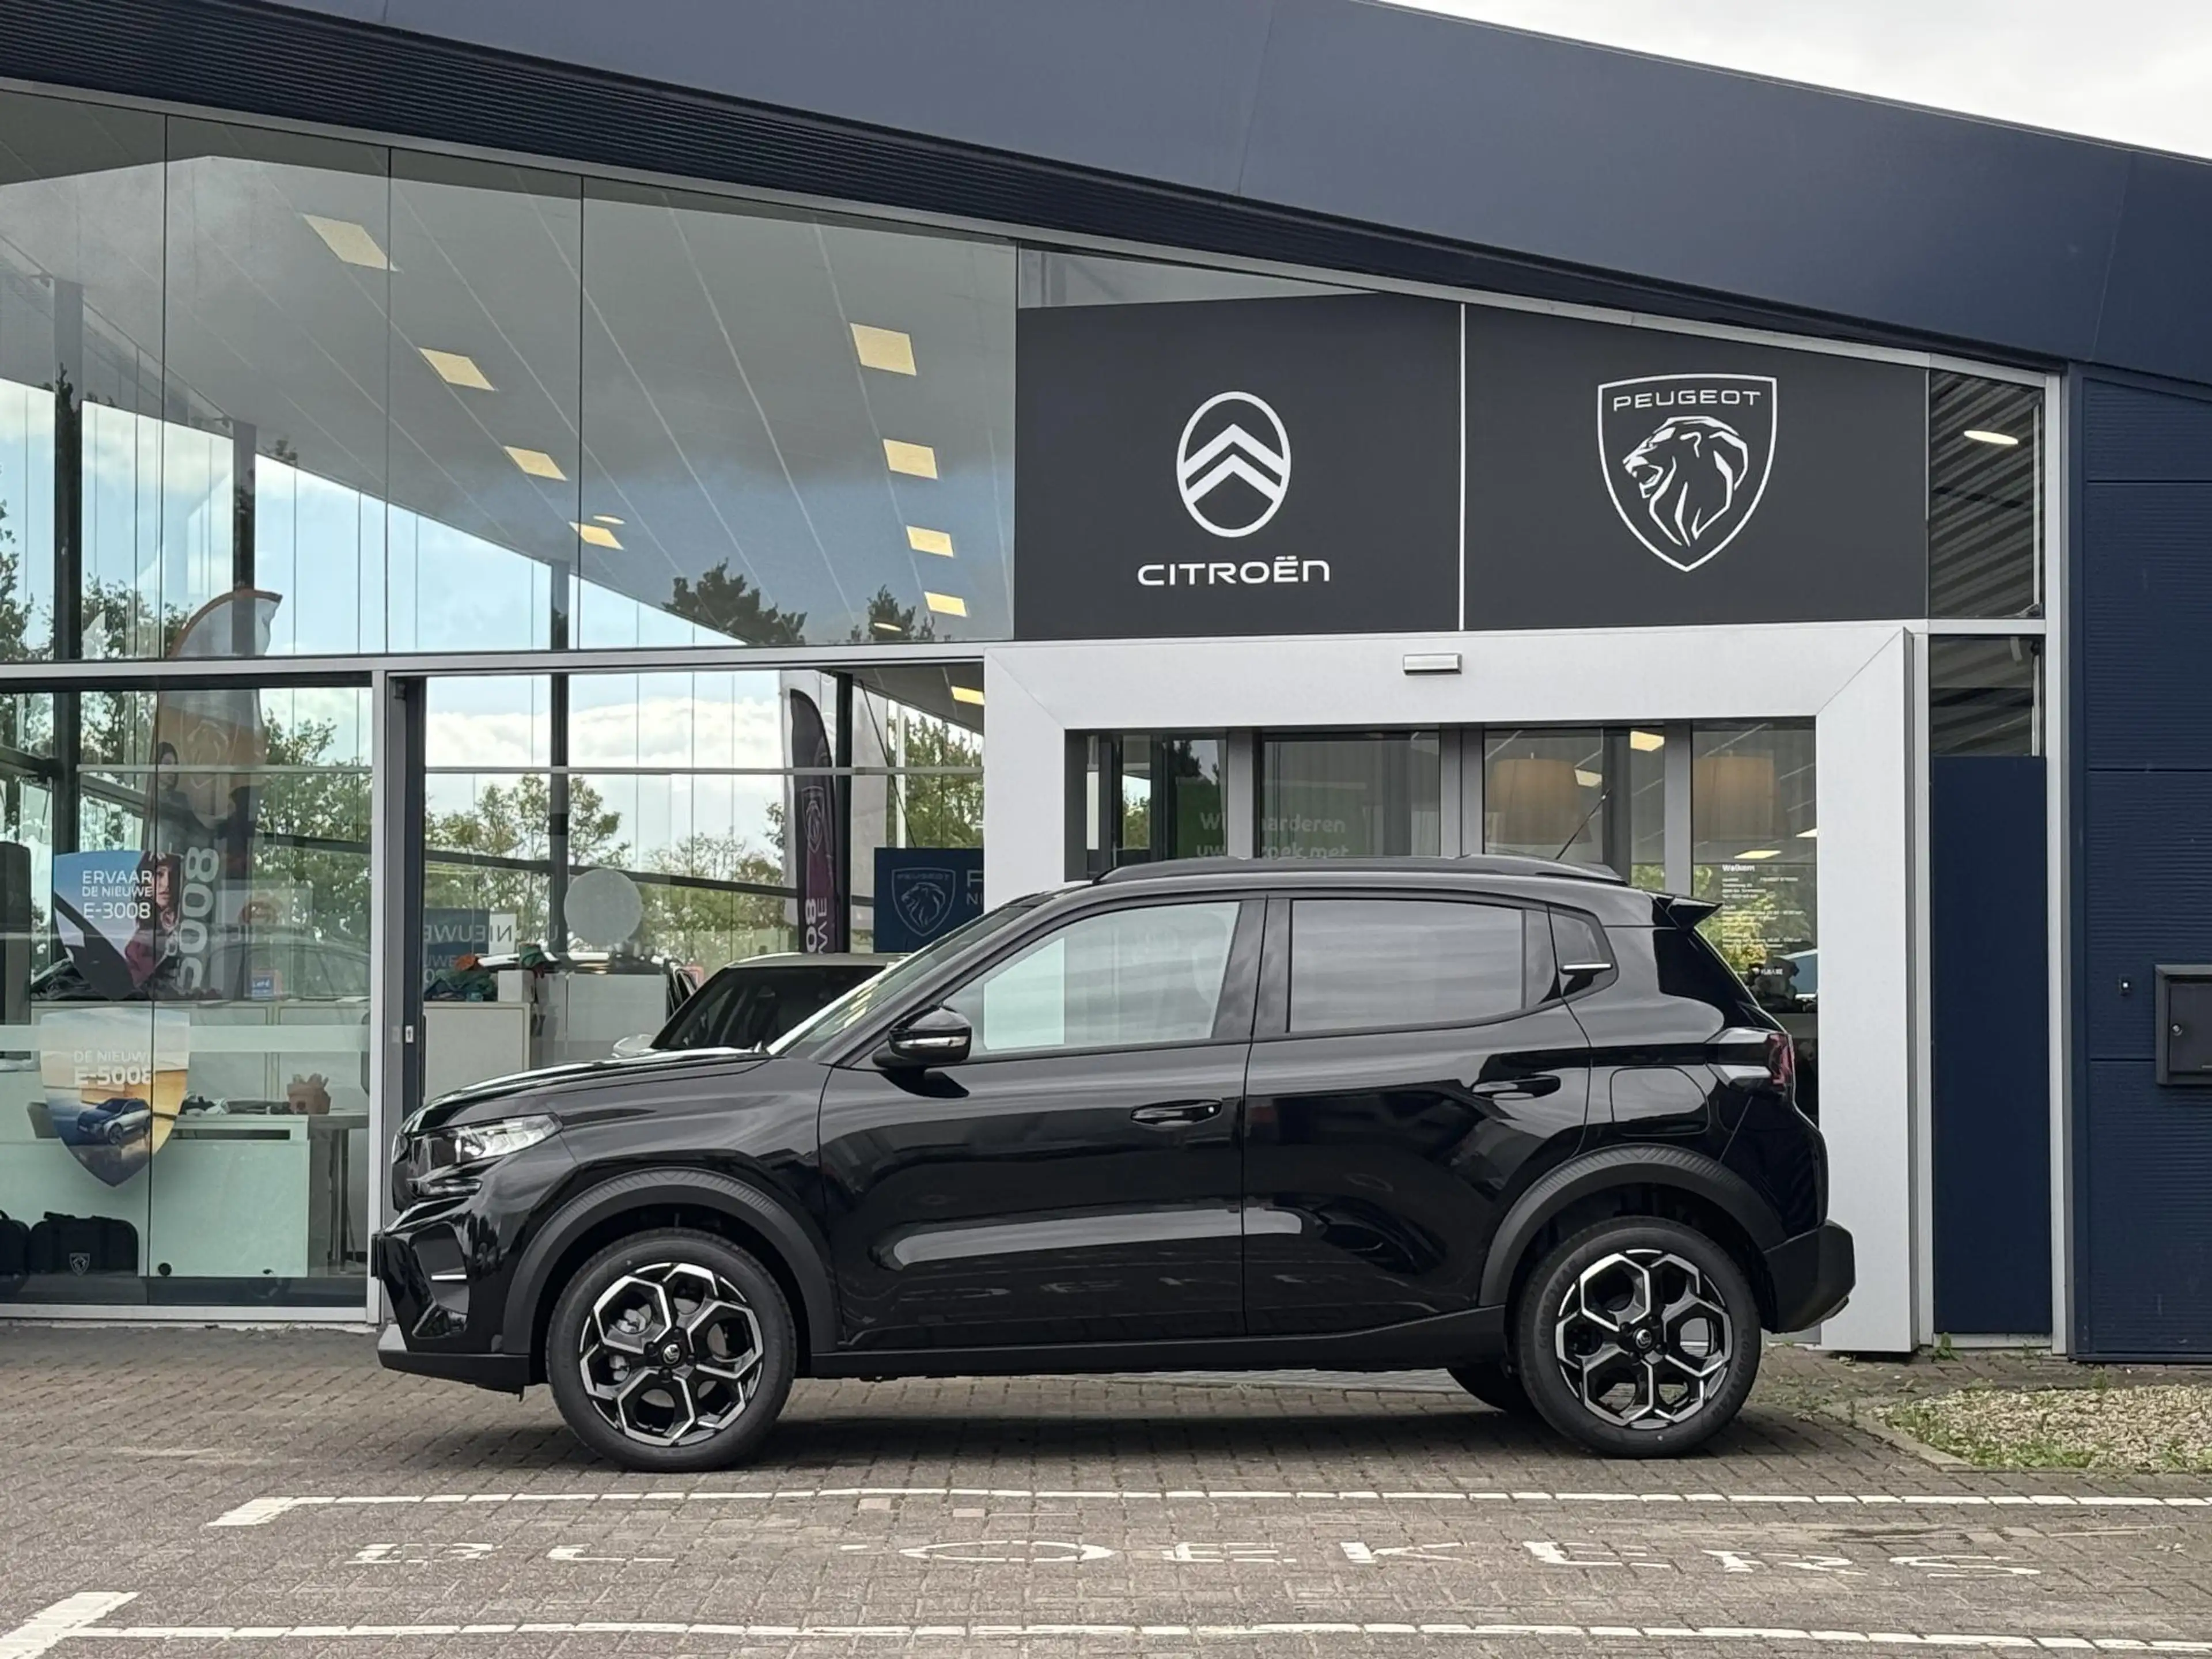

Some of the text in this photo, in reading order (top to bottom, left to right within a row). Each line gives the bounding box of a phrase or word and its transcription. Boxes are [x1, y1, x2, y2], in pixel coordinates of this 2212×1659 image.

[1613, 390, 1761, 411] PEUGEOT
[1137, 555, 1330, 585] CITROËN
[1262, 813, 1346, 833] arderen
[82, 870, 153, 884] ERVAAR
[82, 886, 154, 897] DE NIEUWE
[84, 902, 151, 919] E-3008
